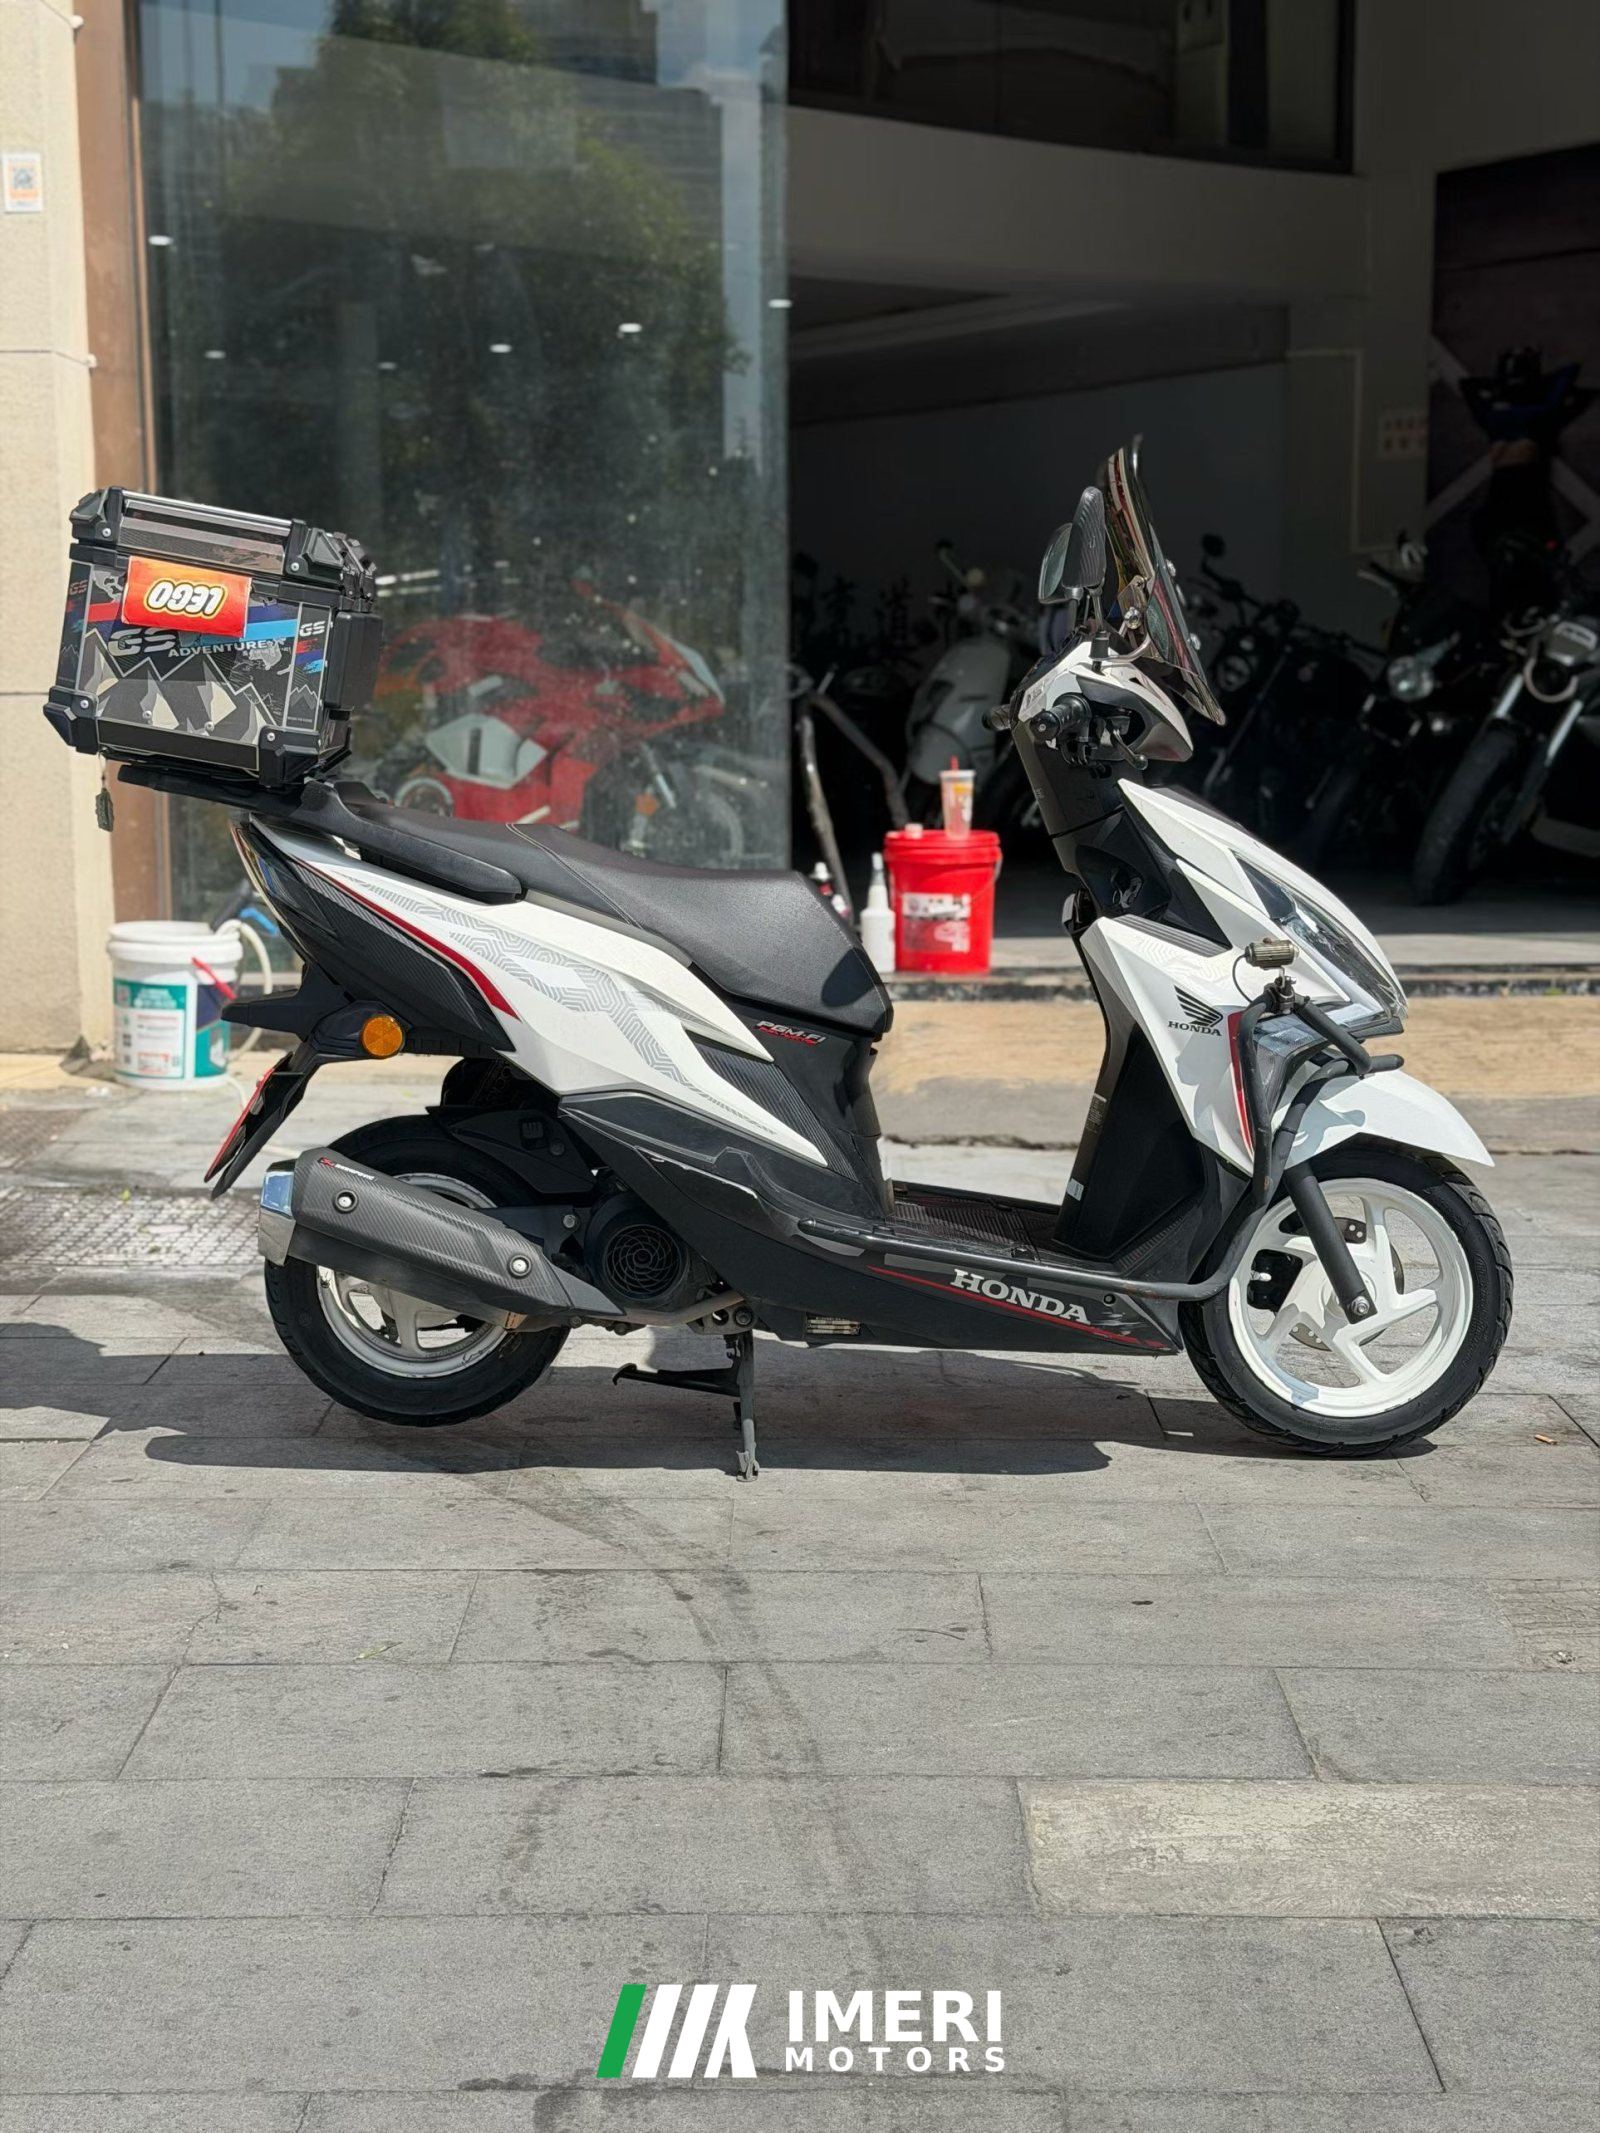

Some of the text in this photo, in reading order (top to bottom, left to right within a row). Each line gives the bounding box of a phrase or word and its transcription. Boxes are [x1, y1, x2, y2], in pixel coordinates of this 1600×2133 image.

[145, 579, 226, 617] LEGO
[300, 620, 326, 637] GS
[107, 628, 177, 657] GS
[167, 640, 267, 658] ADVENTURE
[1166, 1020, 1223, 1037] HONDA
[950, 1268, 1091, 1326] HONDA
